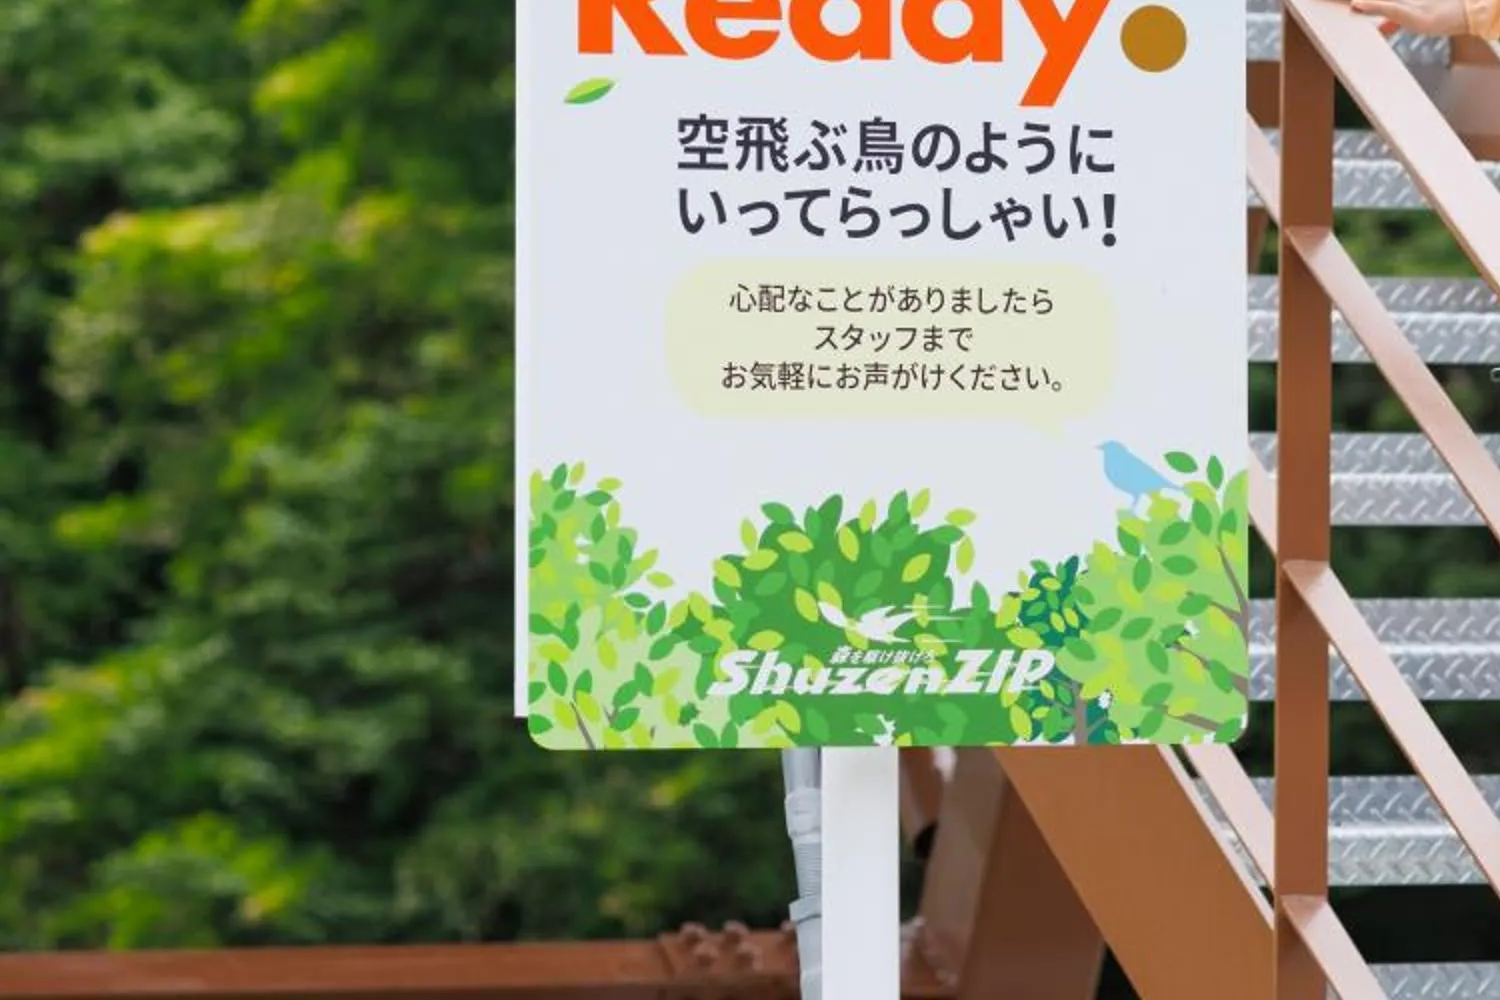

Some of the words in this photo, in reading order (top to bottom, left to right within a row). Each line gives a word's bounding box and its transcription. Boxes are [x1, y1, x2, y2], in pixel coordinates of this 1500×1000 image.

[676, 113, 1116, 176] 空飛ぶ鳥のように
[677, 186, 1118, 248] いってらっしゃい!
[728, 283, 1054, 316] 心配なことがありましたら
[814, 324, 974, 353] スタッフまで
[721, 361, 1063, 393] お気軽にお声がけください。
